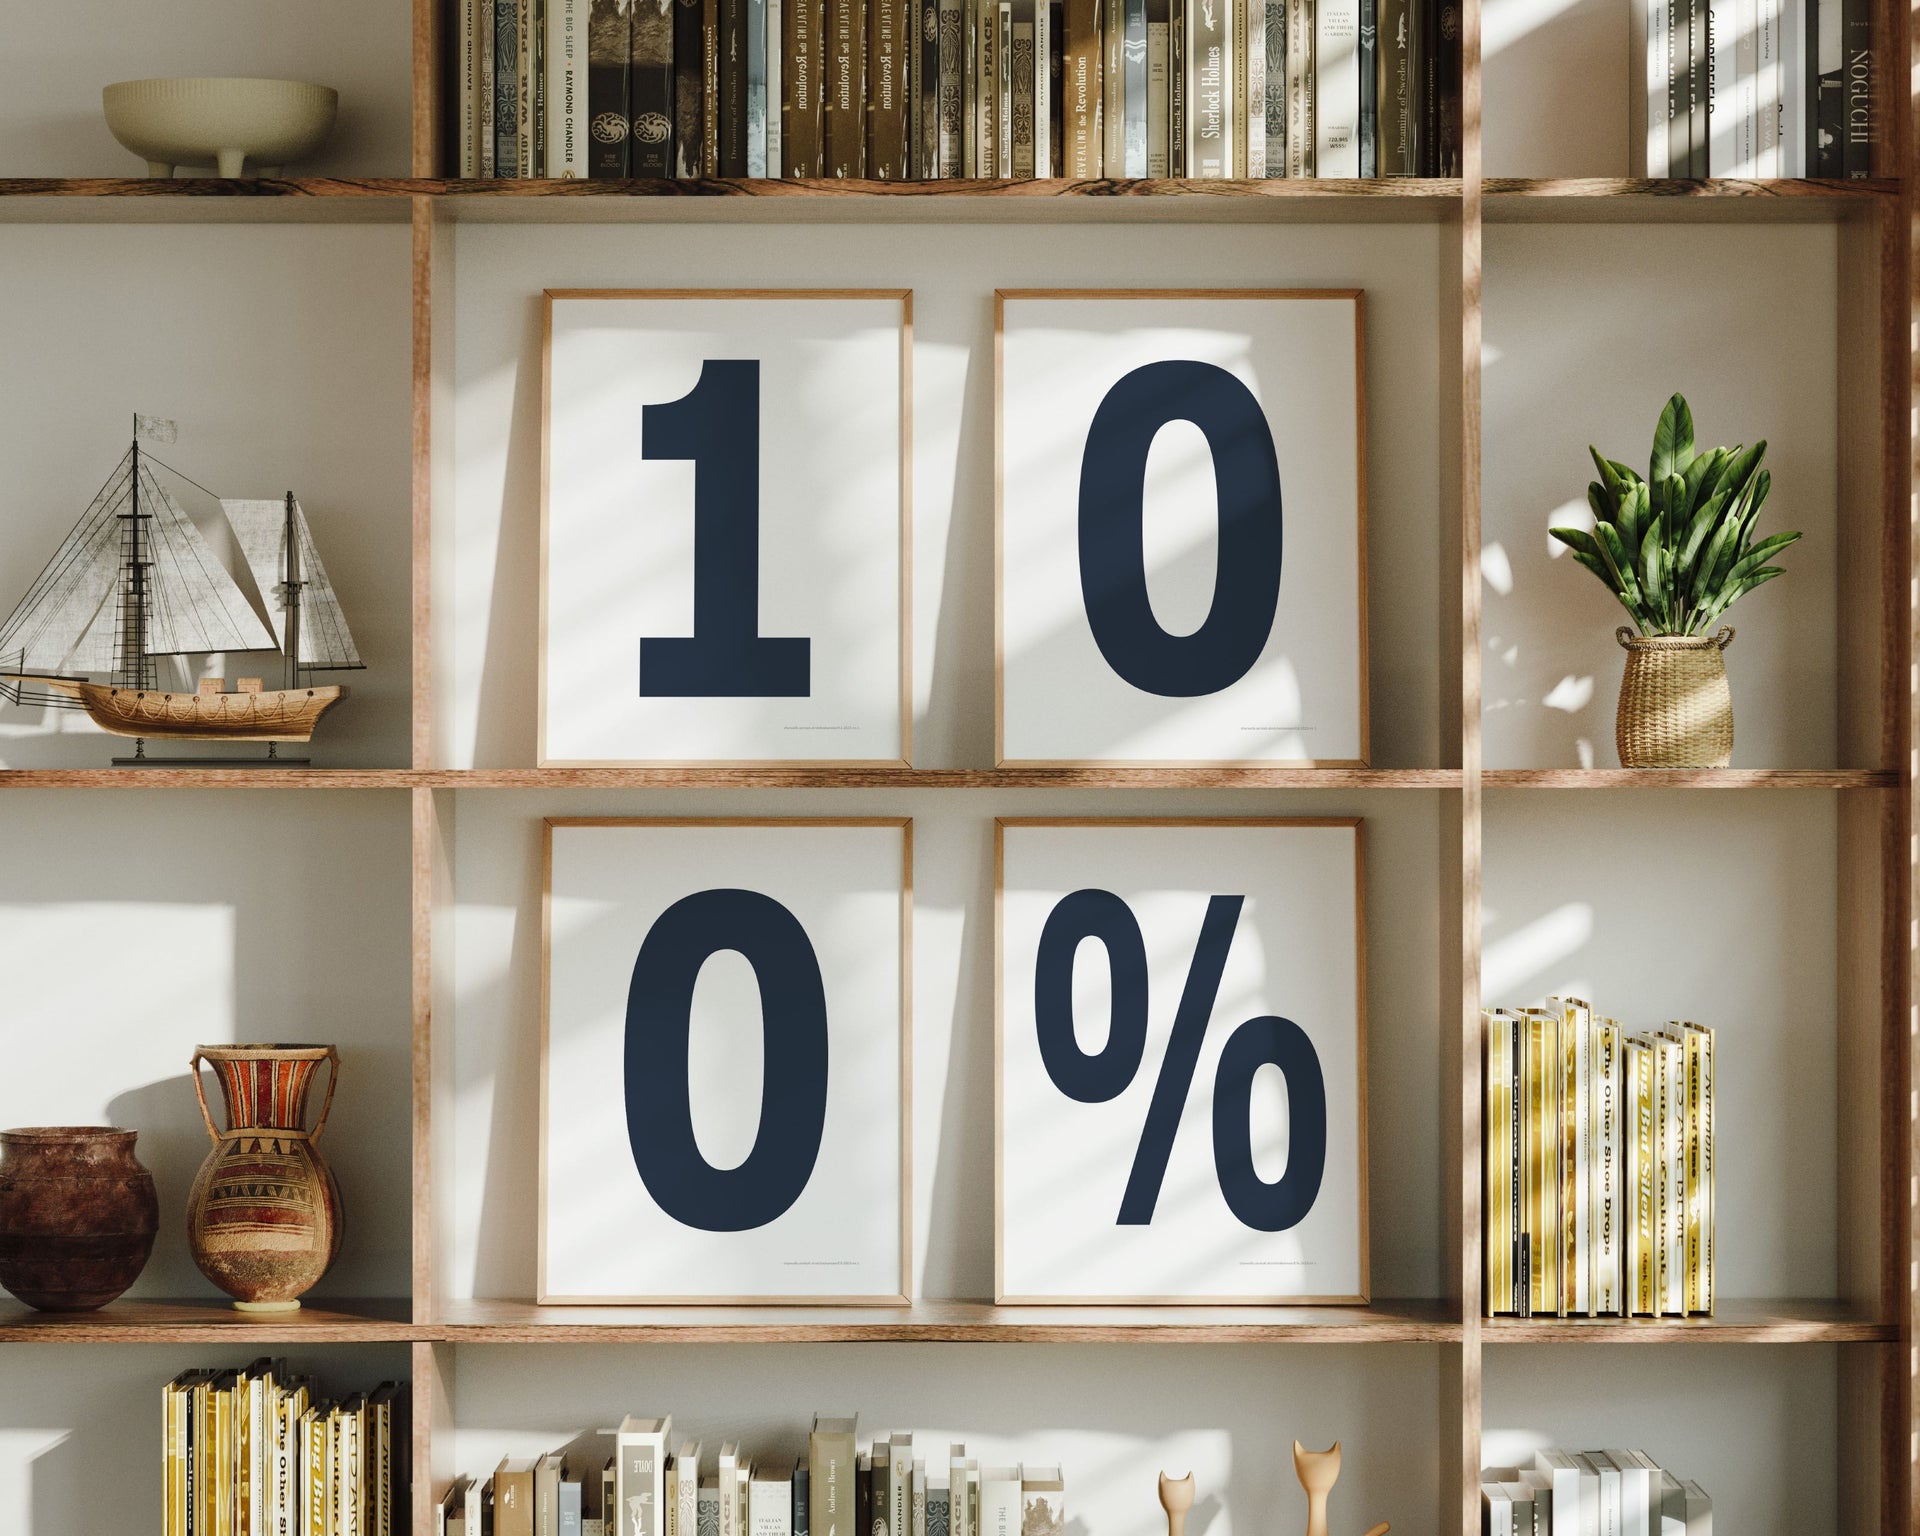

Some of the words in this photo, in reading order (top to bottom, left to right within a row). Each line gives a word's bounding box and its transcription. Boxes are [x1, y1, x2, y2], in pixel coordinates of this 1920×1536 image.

[565, 16, 573, 32] BIG
[565, 36, 573, 59] SLEEP
[984, 17, 993, 78] PEACE
[1075, 56, 1086, 112] Revolution
[1202, 46, 1220, 86] Holmes
[1397, 58, 1406, 95] Sweden
[565, 70, 573, 114] RAYMOND
[1850, 49, 1868, 143] NOGUCHI
[984, 94, 993, 141] WAR
[1078, 116, 1086, 127] the
[1202, 93, 1220, 139] Sherlock
[1397, 106, 1408, 153] Dreaming
[565, 118, 573, 163] CHANDLER
[984, 146, 993, 179] LSTOY
[1077, 130, 1086, 178] REVEALING
[640, 360, 810, 697] 1
[1079, 360, 1282, 697] 0
[624, 889, 828, 1232] 0
[1035, 889, 1326, 1231] %
[1640, 1105, 1651, 1154] But
[1691, 1114, 1697, 1130] of
[1640, 1160, 1651, 1240] Silent
[1603, 1198, 1611, 1256] Drops
[633, 1460, 653, 1473] DOYLE
[828, 1459, 836, 1483] Brown
[312, 1476, 323, 1526] But
[828, 1483, 836, 1514] Andrew
